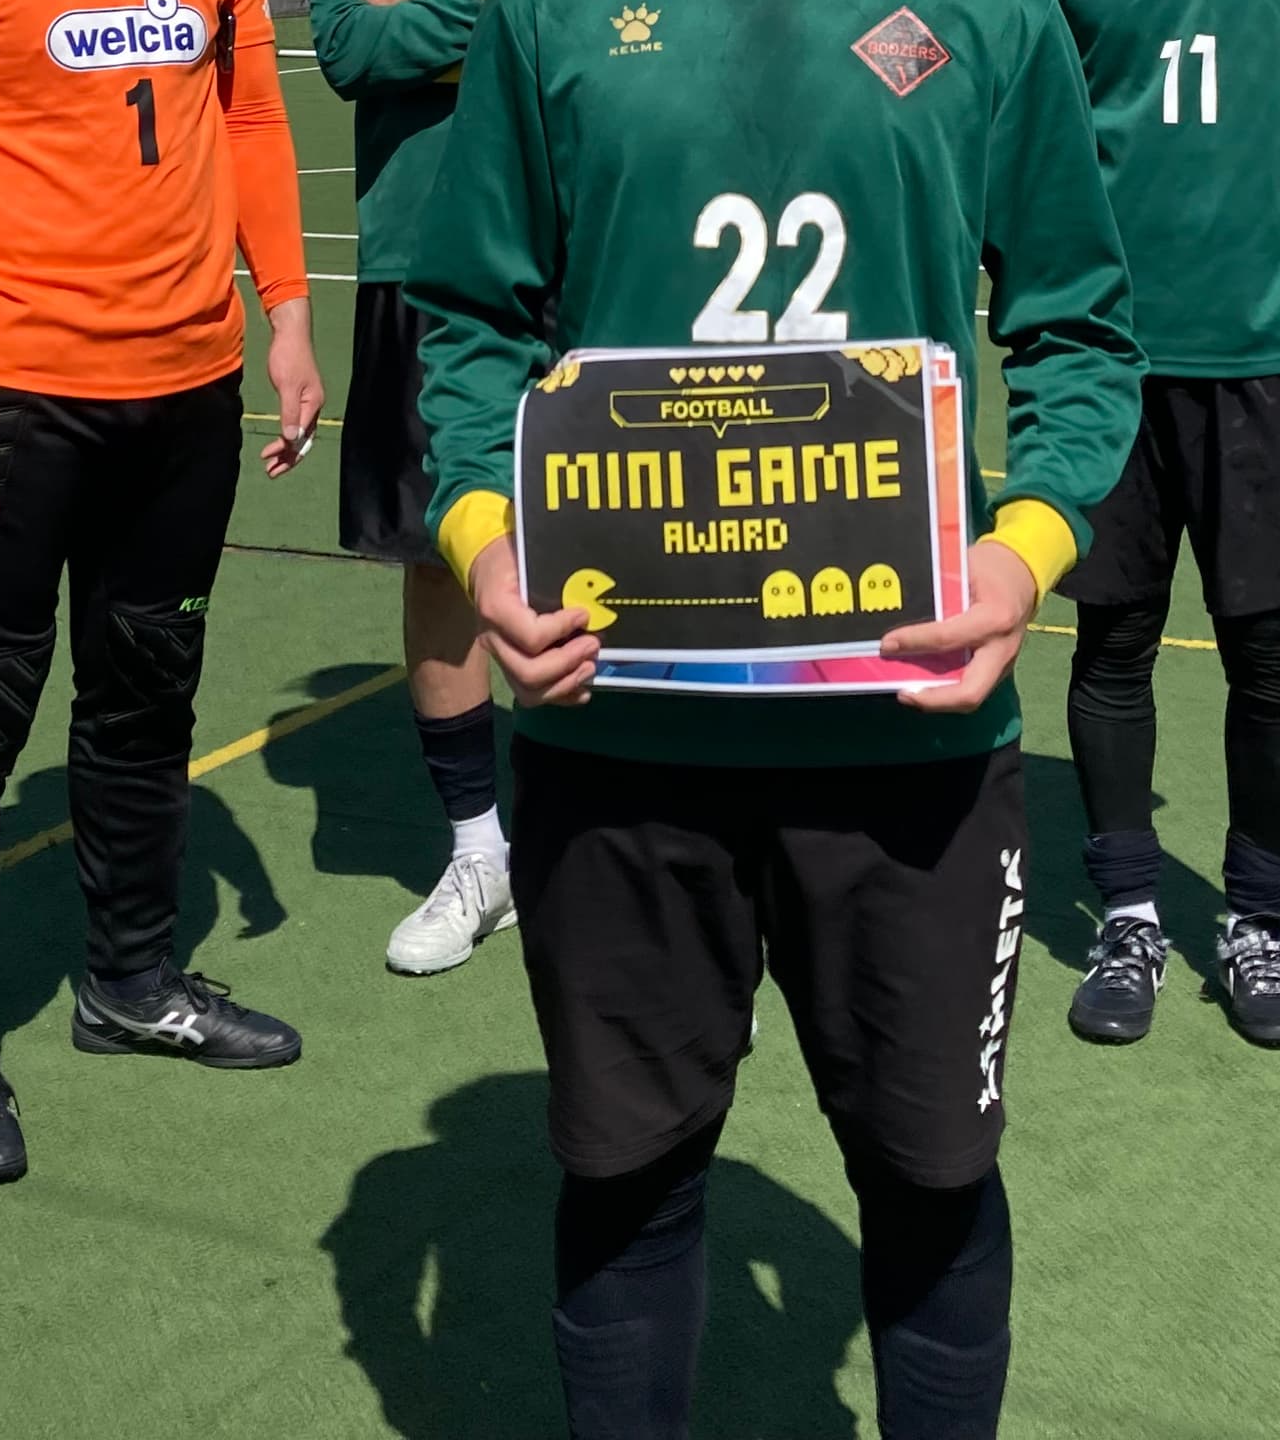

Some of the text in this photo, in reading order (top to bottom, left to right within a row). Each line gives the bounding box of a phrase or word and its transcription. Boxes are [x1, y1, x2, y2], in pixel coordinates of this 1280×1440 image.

[64, 16, 195, 57] welcia
[608, 41, 664, 56] KELME
[867, 40, 938, 61] BOOZERS
[1159, 34, 1218, 124] 11
[125, 78, 160, 166] 1
[691, 192, 848, 343] 22
[660, 397, 774, 420] FOOTBALL
[545, 439, 902, 511] MINI GAME
[663, 517, 789, 555] AWARD
